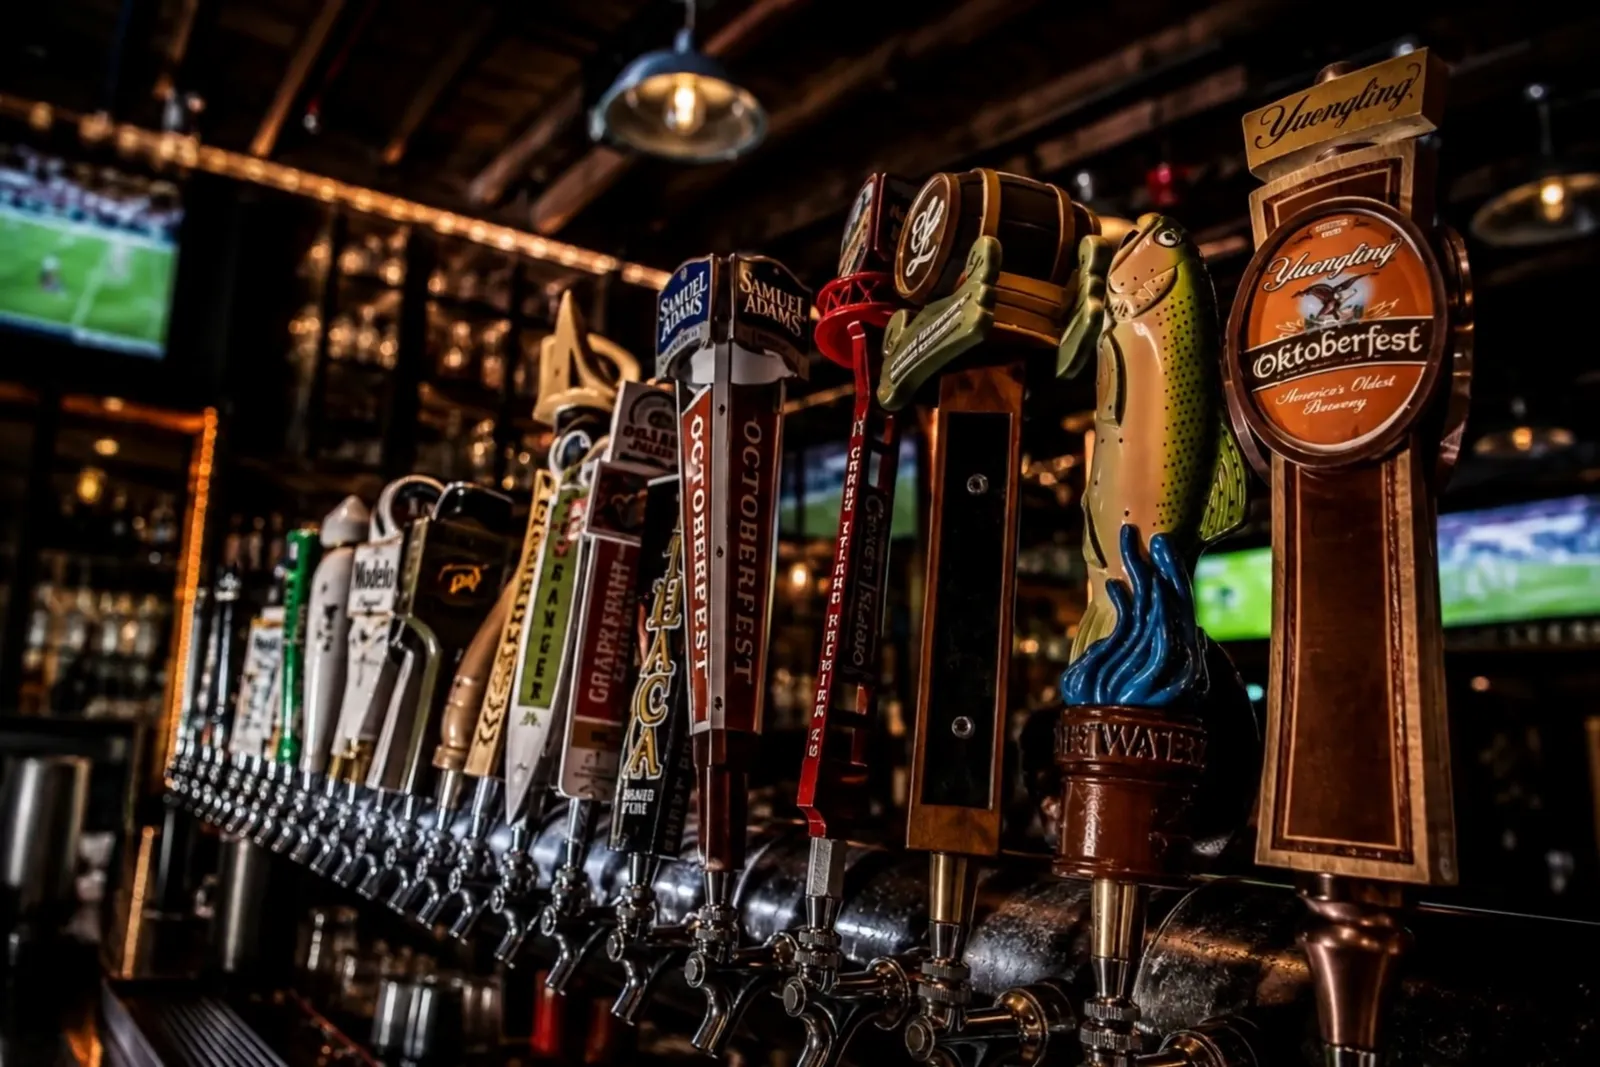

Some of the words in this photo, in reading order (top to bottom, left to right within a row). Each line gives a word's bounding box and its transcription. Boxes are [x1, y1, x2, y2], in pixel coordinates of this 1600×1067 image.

[1255, 63, 1421, 150] Yuengling
[1263, 238, 1404, 292] Yuengling
[660, 271, 709, 321] SAMUEL
[660, 294, 703, 343] ADAMS
[739, 270, 804, 319] SAMUEL
[744, 295, 802, 337] ADAMS
[1253, 324, 1423, 380] Oktoberfest
[1276, 385, 1345, 406] America's
[1351, 374, 1397, 393] Oldest
[1303, 398, 1368, 416] Brewery
[690, 413, 709, 679] OCTOBERFEST
[734, 416, 763, 685] OCTOBERFEST
[530, 563, 564, 702] RANGER
